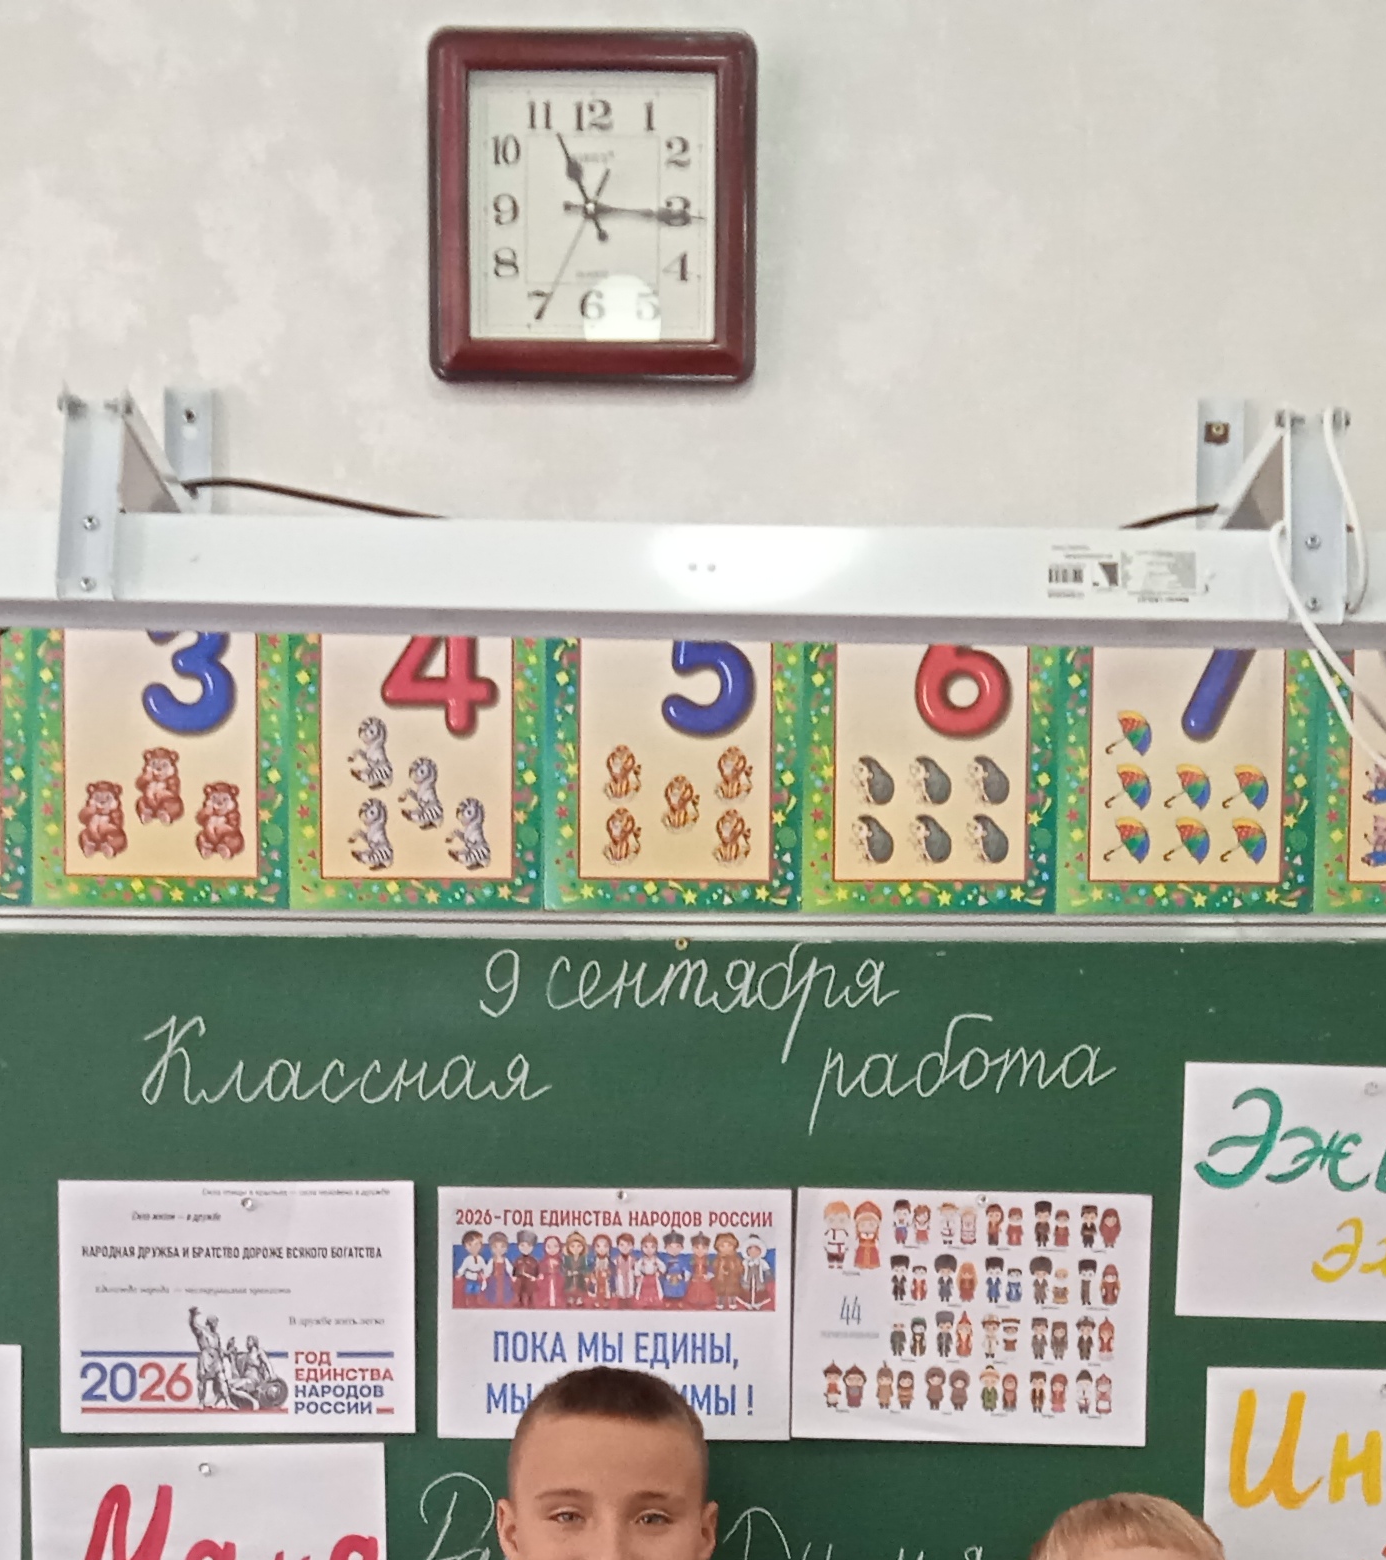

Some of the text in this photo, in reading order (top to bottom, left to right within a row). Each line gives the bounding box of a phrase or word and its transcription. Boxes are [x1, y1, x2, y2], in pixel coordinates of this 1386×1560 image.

[527, 100, 553, 130] 11
[574, 100, 613, 131] 12
[644, 101, 655, 131] 1
[492, 135, 521, 165] 10
[665, 136, 691, 168] 2
[493, 193, 519, 225] 9
[664, 196, 692, 227] 3
[493, 247, 519, 278] 8
[663, 251, 689, 282] 4
[527, 289, 553, 320] 7
[580, 289, 606, 321] 6
[636, 291, 660, 321] 5
[140, 629, 238, 736] 3
[380, 634, 499, 737] 4
[479, 943, 902, 1064] 9 сентября
[141, 1014, 1117, 1137] Классная работа
[540, 1210, 622, 1228] ЕДИНСТВА
[629, 1210, 702, 1228] НАРОДОВ
[709, 1210, 773, 1228] РОССИИ
[82, 1246, 382, 1260] НАРОДНАЯ ДРУЖБА И БРАТСТВО ДОРОЖЕ ВСЯКОГО БОГАТСТВА
[840, 1295, 862, 1326] 44
[295, 1351, 331, 1367] ГОД
[493, 1330, 739, 1369] ПОКА МЫ ЕДИНЫ,
[80, 1361, 193, 1403] 2026
[295, 1368, 394, 1383] ЕДИНСТВА
[295, 1385, 384, 1400] НАРОДОВ
[295, 1401, 372, 1415] РОССИИ
